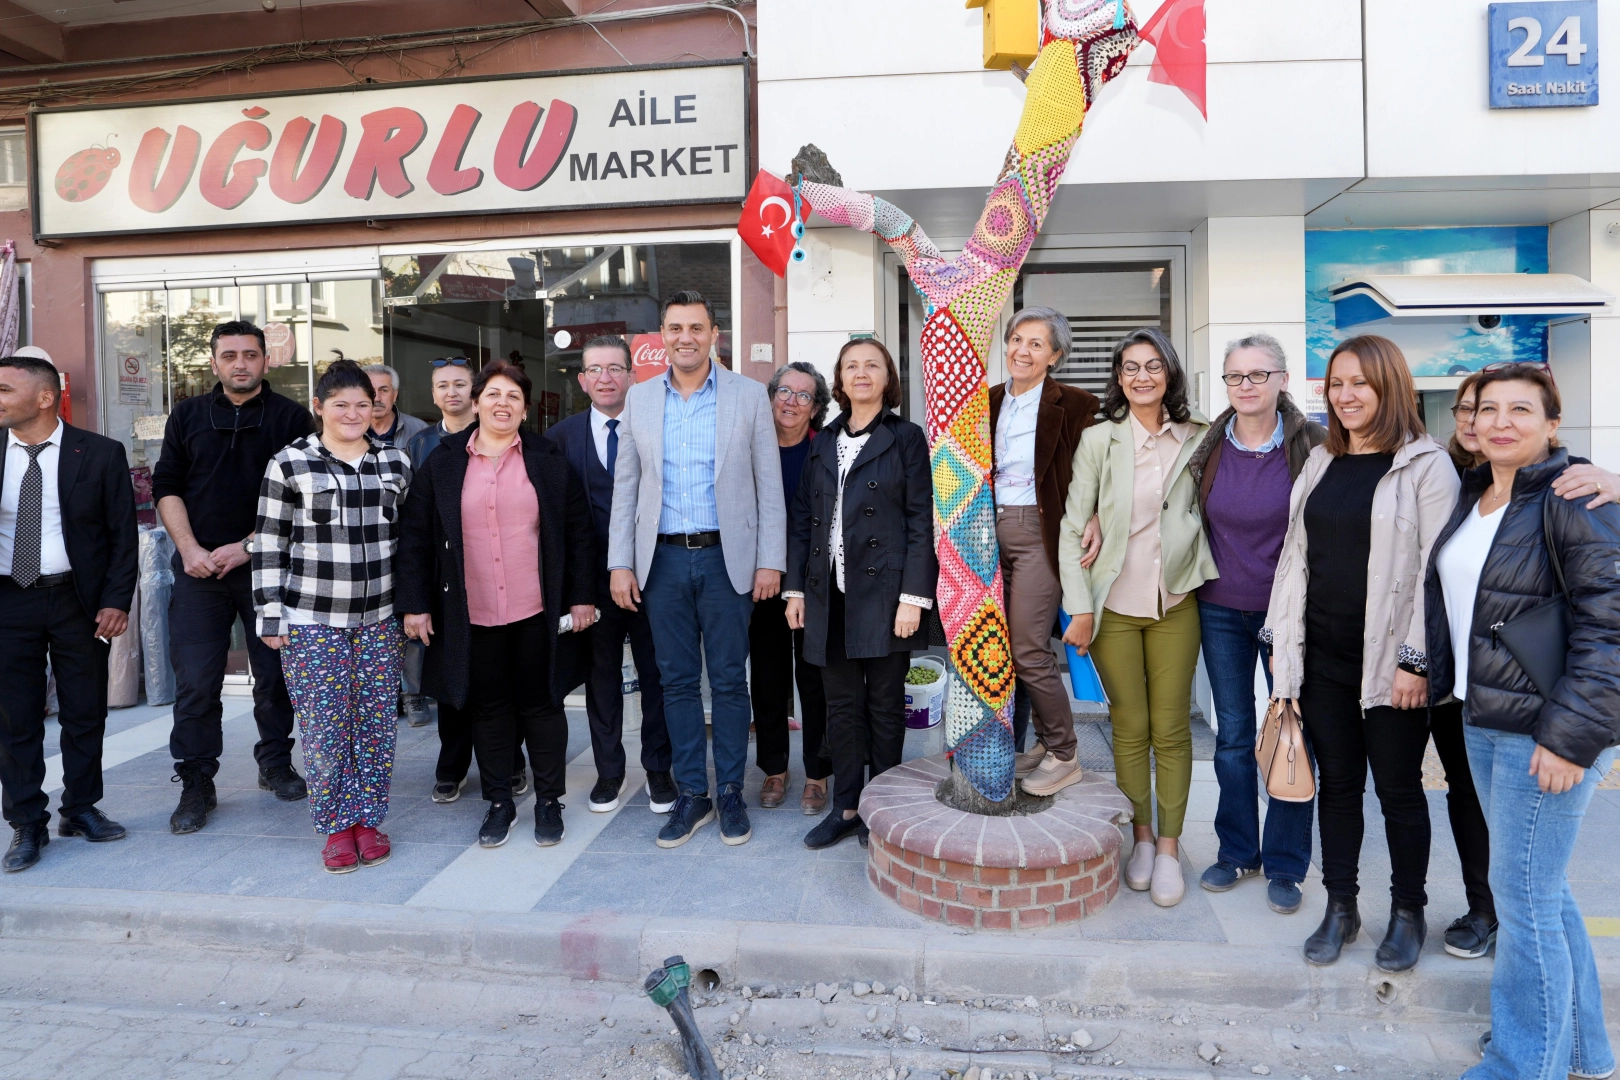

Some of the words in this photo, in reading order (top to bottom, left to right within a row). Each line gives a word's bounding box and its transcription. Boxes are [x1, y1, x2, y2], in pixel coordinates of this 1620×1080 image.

[1507, 15, 1588, 68] 24
[1507, 82, 1542, 96] Saat
[1546, 80, 1587, 95] Nakit
[608, 90, 697, 127] AİLE
[128, 98, 578, 213] UĞURLU
[570, 144, 738, 182] MARKET
[633, 343, 666, 367] Coca
